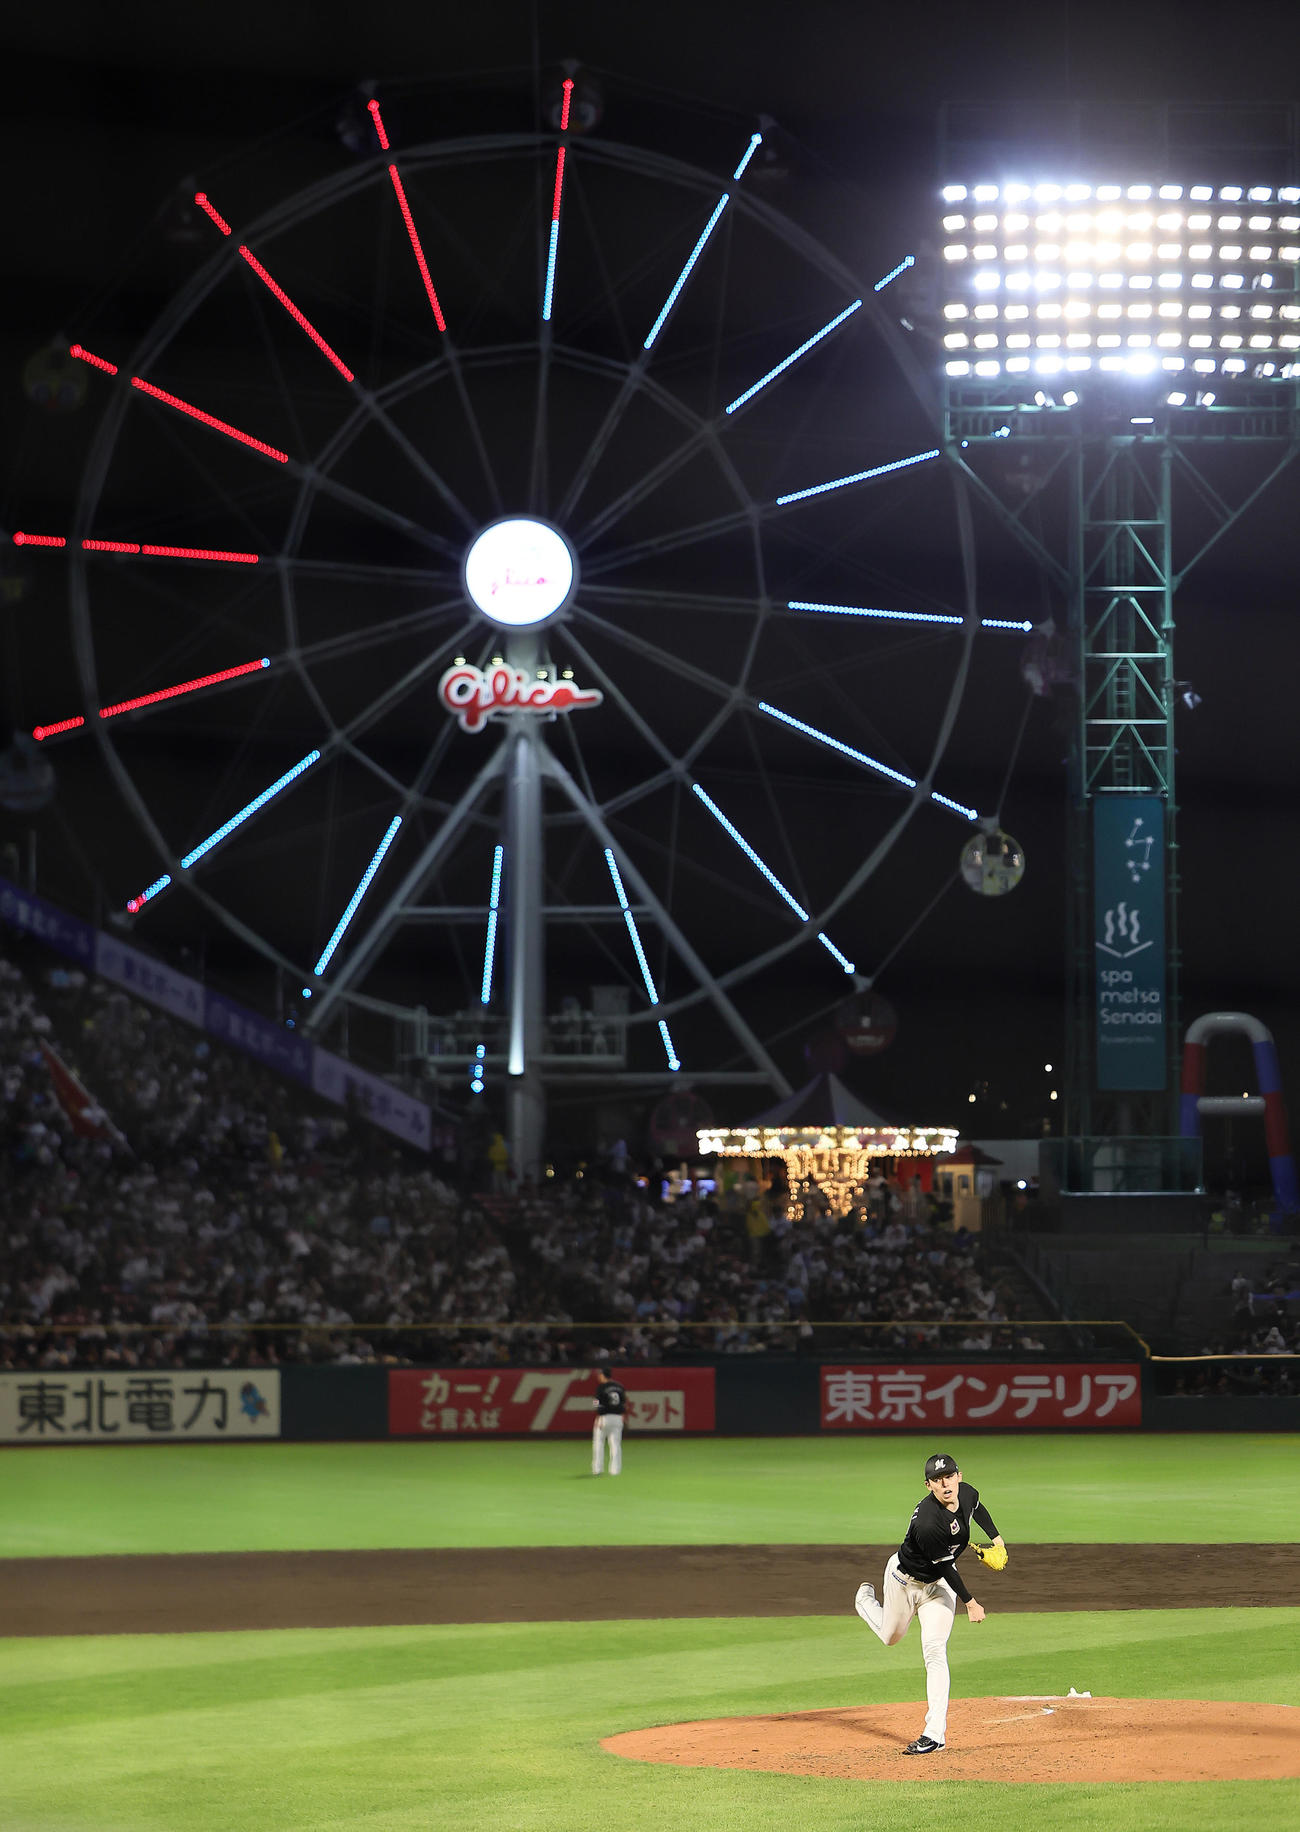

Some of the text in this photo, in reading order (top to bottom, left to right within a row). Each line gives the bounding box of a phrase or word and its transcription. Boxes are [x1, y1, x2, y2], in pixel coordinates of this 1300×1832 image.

[1100, 970, 1133, 986] spa
[1100, 1007, 1162, 1024] Sendai
[16, 1378, 229, 1433] 東北電力
[824, 1369, 1137, 1421] 東京インテリア
[420, 1407, 502, 1430] と言えば
